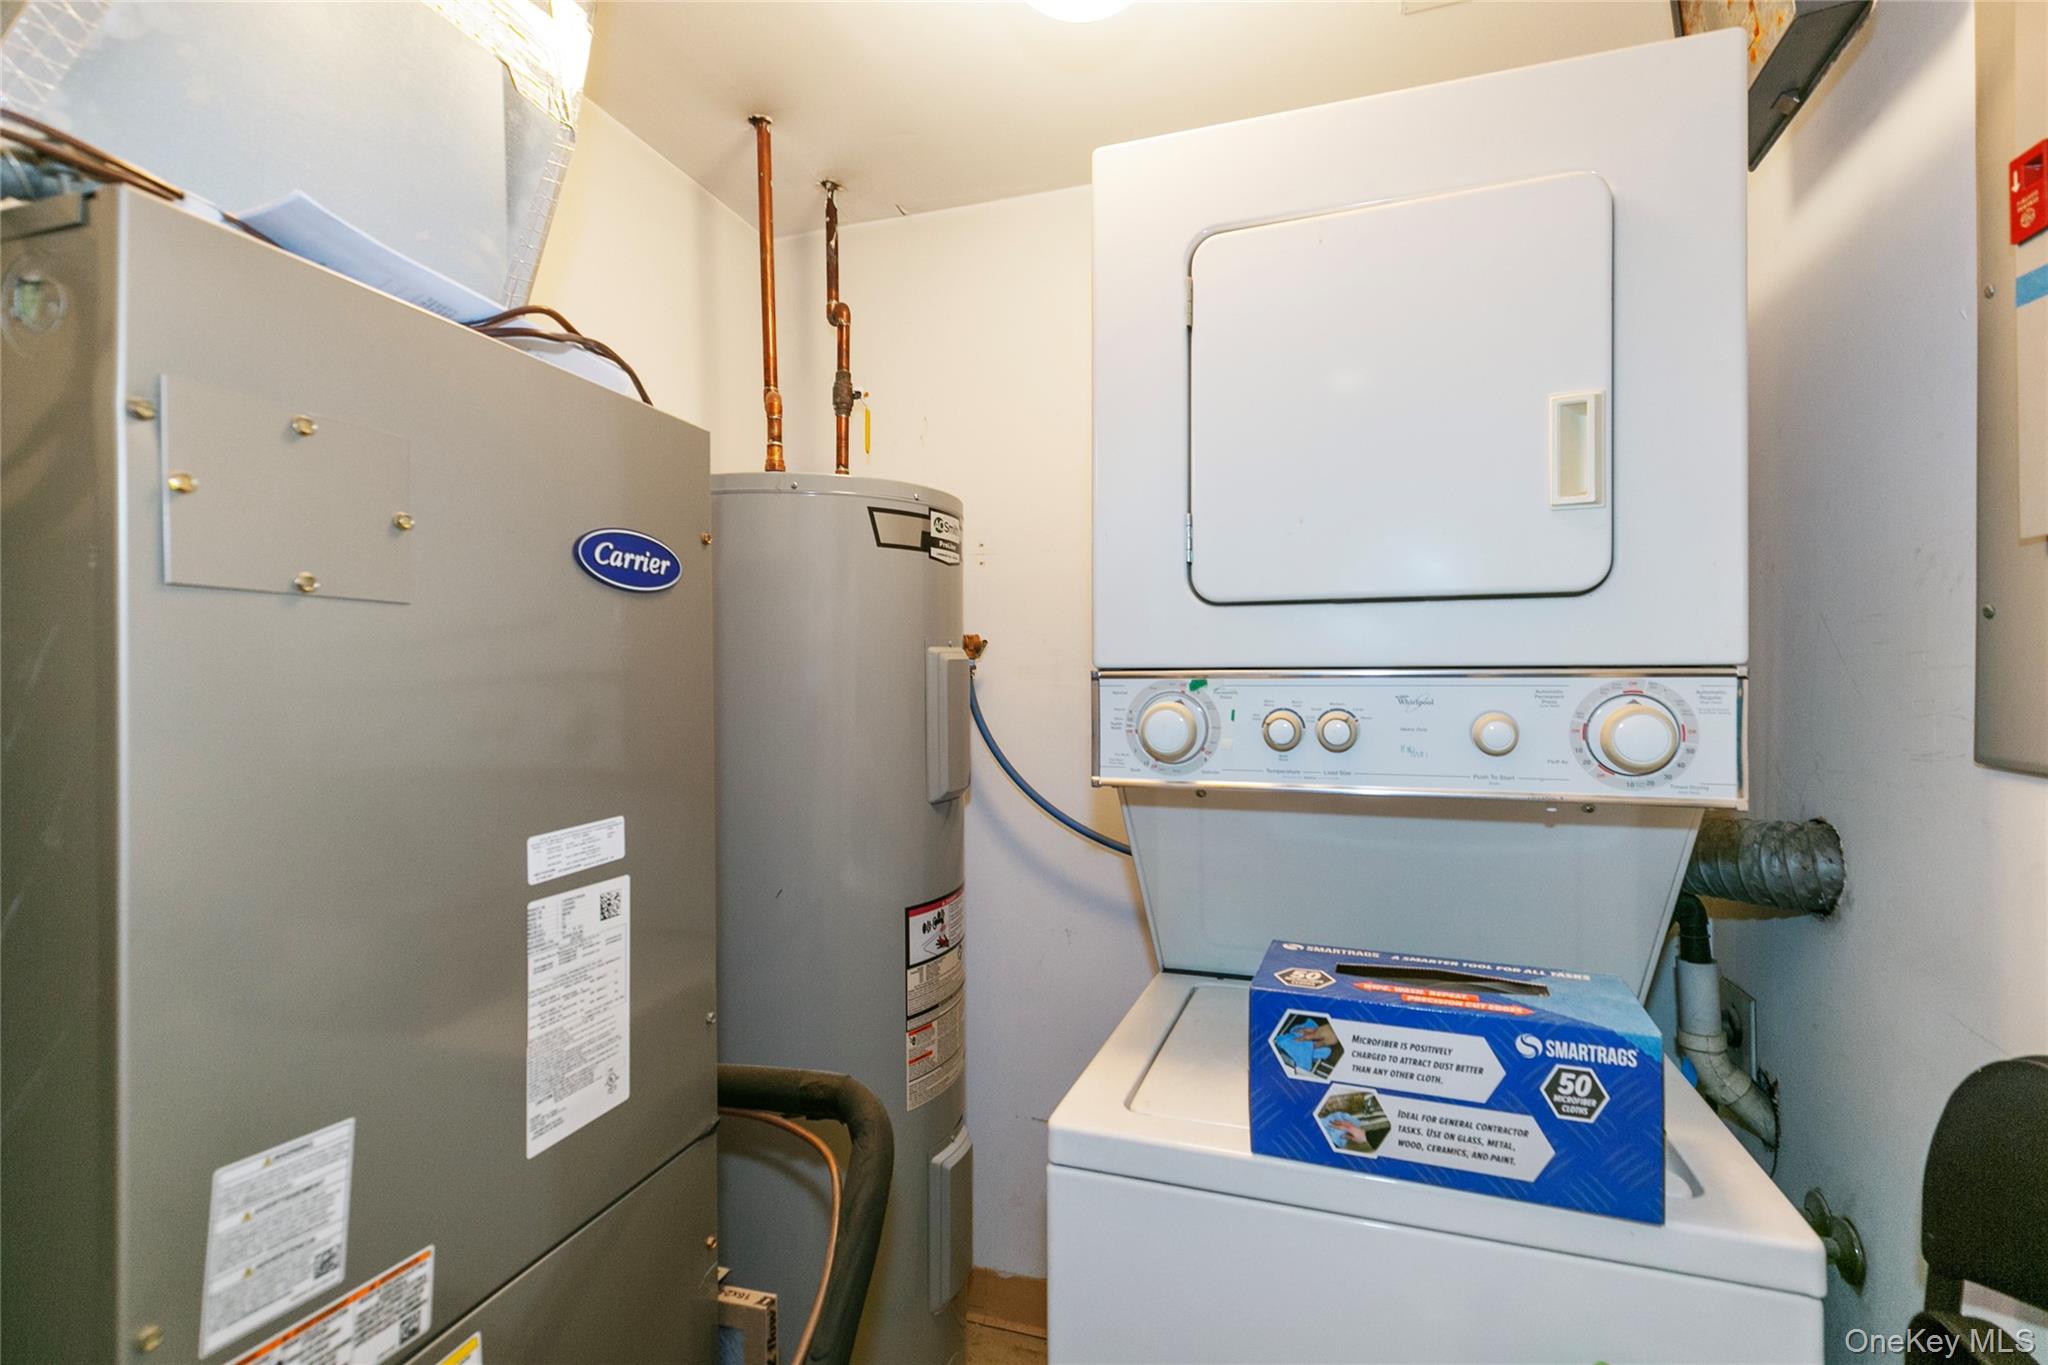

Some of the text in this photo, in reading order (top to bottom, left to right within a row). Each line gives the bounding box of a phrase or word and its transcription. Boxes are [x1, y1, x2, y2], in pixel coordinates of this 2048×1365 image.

[594, 541, 671, 575] Carrier
[1395, 695, 1434, 708] Whirlpool
[1306, 945, 1380, 959] SMARTRAGS
[1402, 956, 1459, 967] SMARTER
[1462, 961, 1493, 971] TOOL
[1496, 965, 1521, 974] FOR
[1523, 968, 1546, 976] ALL
[1550, 971, 1591, 981] TASKS
[1401, 1042, 1408, 1050] IS
[1410, 1043, 1453, 1056] POSITIVELY
[1545, 1039, 1638, 1069] SMARTRAGS
[1352, 1050, 1484, 1075] CHARGED TO ATTRACT DUST BETTER
[1352, 1064, 1371, 1074] THAN
[1373, 1067, 1388, 1076] ANY
[1390, 1070, 1415, 1080] OTHER
[1557, 1071, 1593, 1098] 50
[1552, 1094, 1598, 1108] MICROFIBER
[1561, 1104, 1589, 1116] CLOTHS
[1422, 1114, 1437, 1123] FOR
[1439, 1117, 1473, 1130] GENERAL
[1476, 1122, 1529, 1137] CONTRACTOR
[1444, 1133, 1456, 1142] ON
[1472, 1151, 1489, 1161] AND
